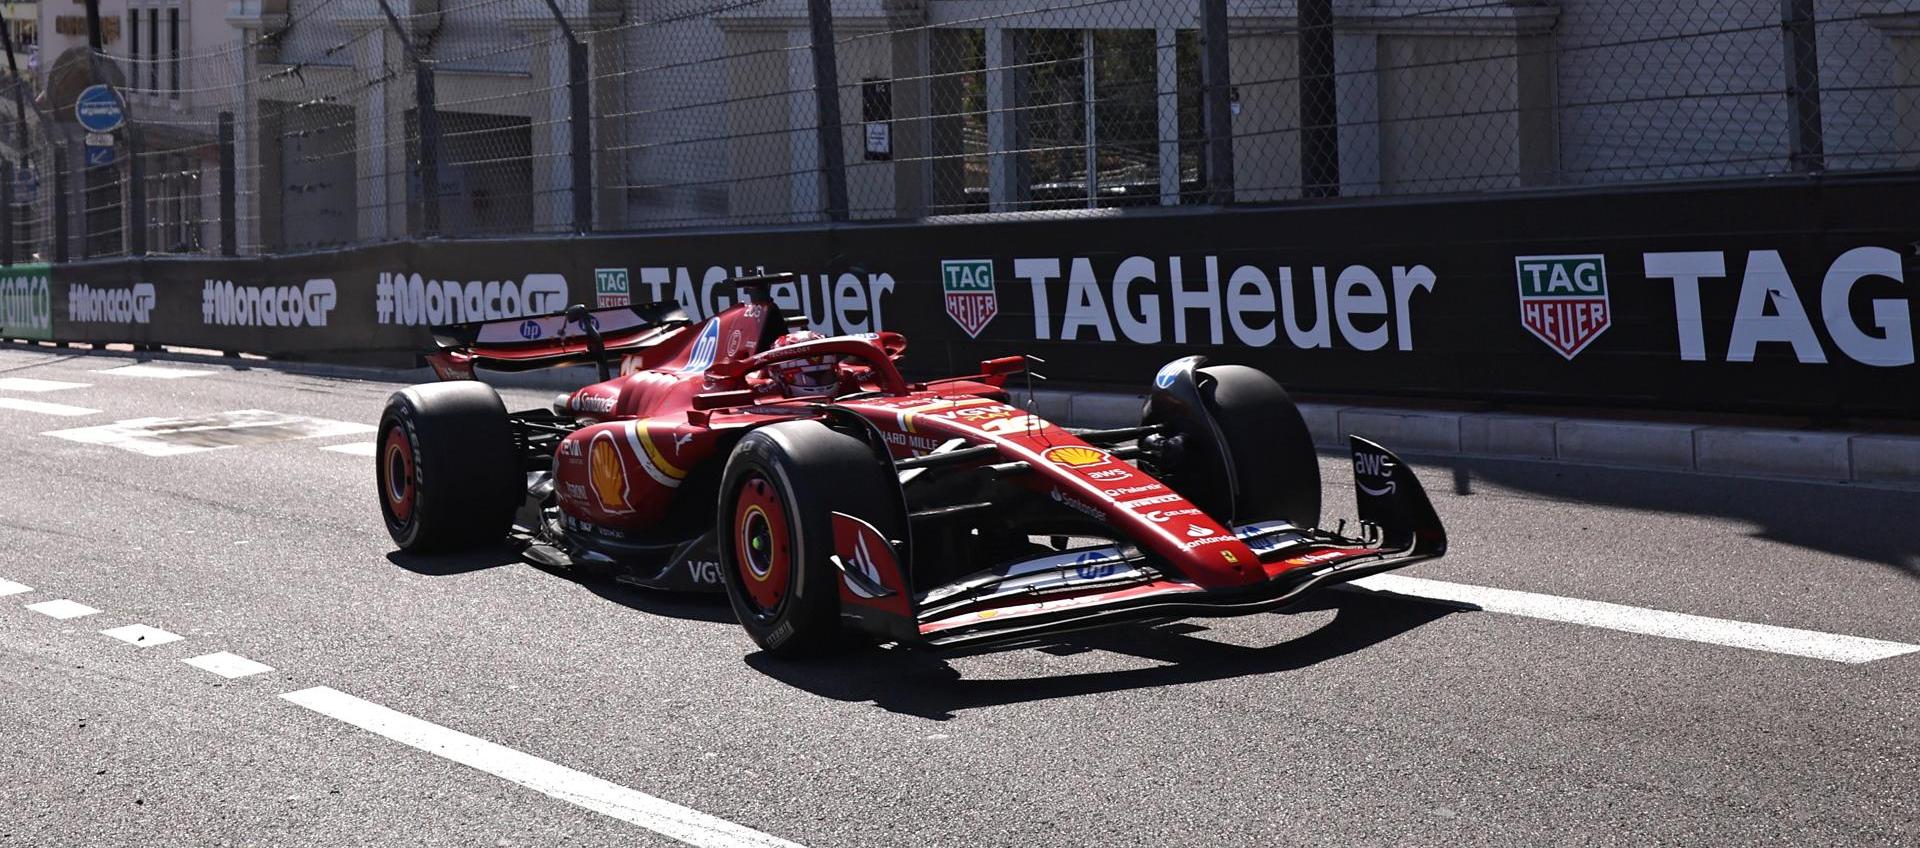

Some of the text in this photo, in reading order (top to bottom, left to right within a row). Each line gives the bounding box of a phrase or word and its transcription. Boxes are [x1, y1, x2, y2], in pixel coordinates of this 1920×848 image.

[598, 272, 627, 292] TAG
[947, 265, 990, 289] TAG
[1524, 263, 1599, 293] TAG
[69, 283, 156, 324] #MonacoGP
[202, 278, 337, 327] #MonacoGP
[948, 293, 996, 332] HEUER
[521, 321, 541, 340] hp
[1524, 300, 1605, 350] HEUER
[981, 414, 1050, 436] 16
[908, 435, 939, 451] MILLE
[1088, 468, 1127, 479] aws
[1354, 451, 1393, 477] aws
